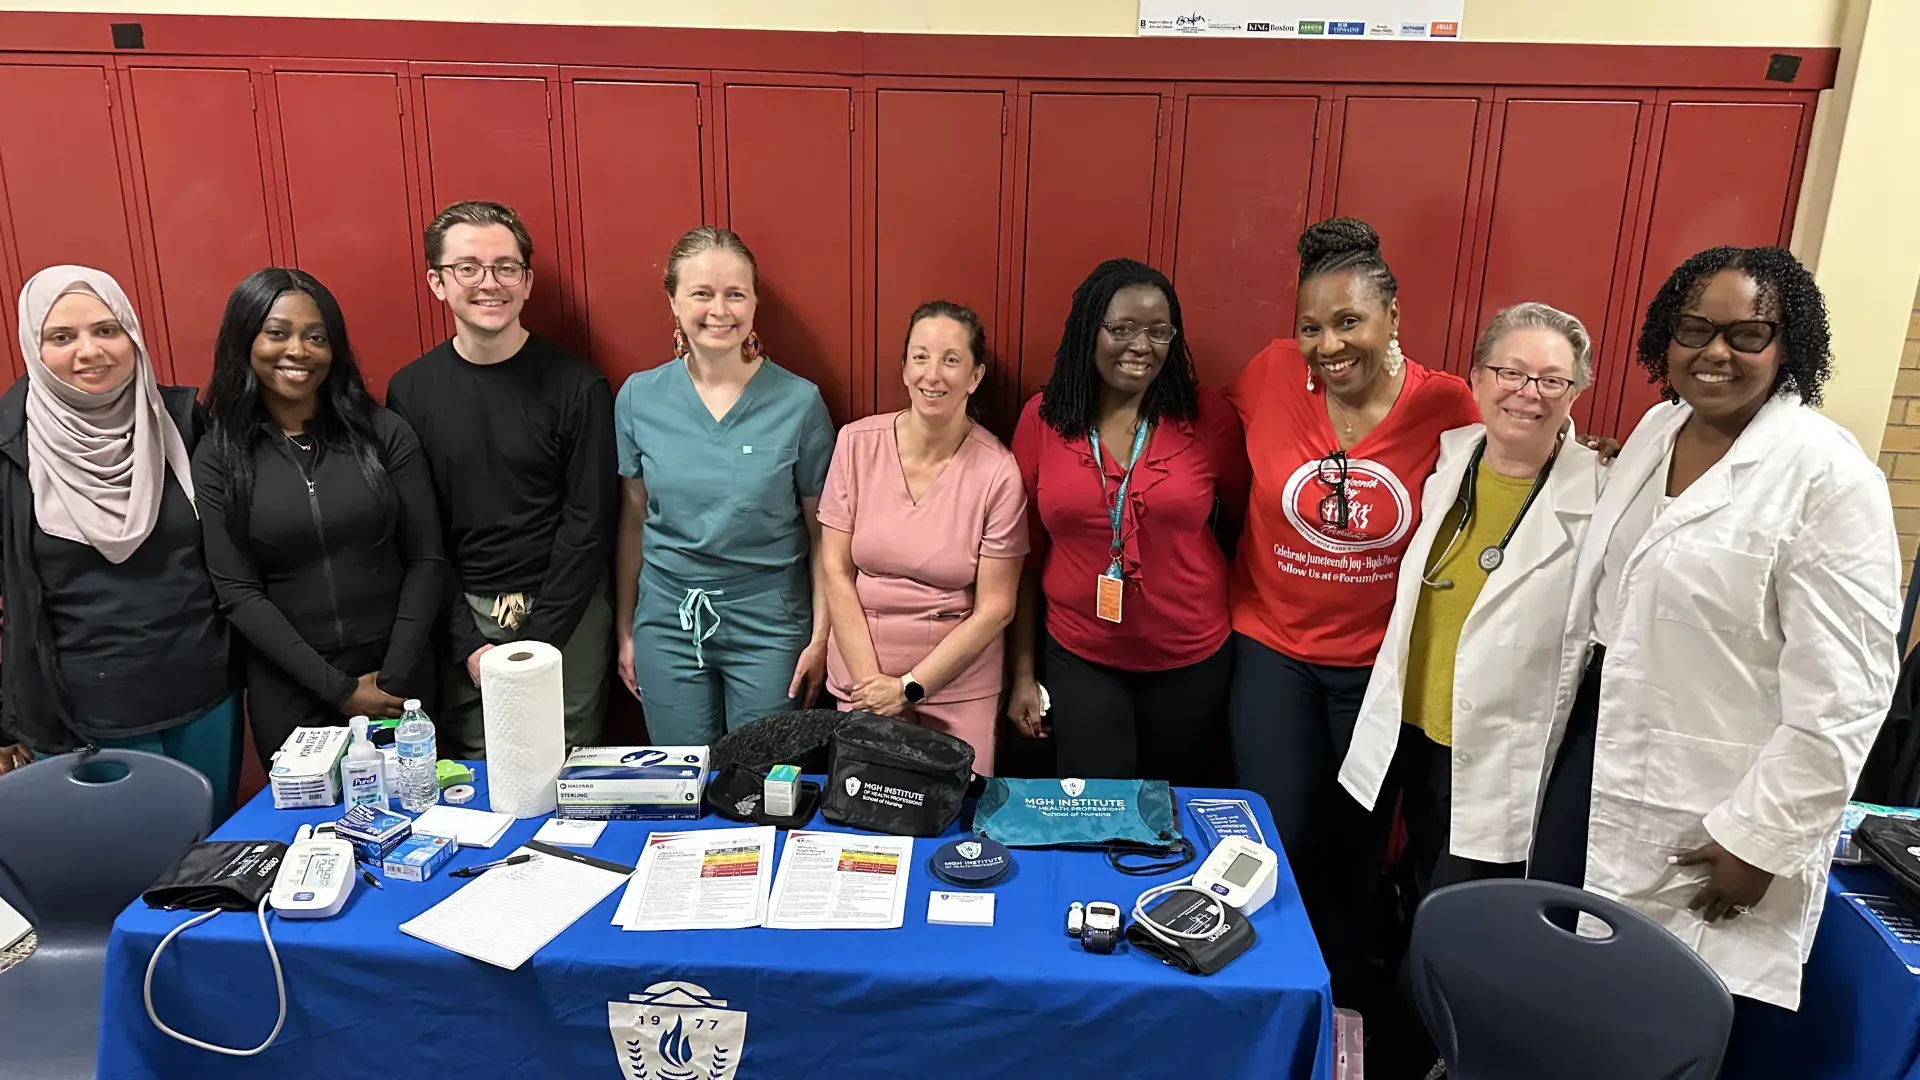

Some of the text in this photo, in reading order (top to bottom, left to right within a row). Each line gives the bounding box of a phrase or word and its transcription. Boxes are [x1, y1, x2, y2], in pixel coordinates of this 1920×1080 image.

[1316, 540, 1330, 550] HYDE
[1273, 543, 1306, 563] Celebrate
[1305, 552, 1348, 569] Juneteenth
[1347, 557, 1362, 572] Joy
[1366, 555, 1383, 571] Hyde
[1277, 561, 1306, 577] Follow
[1309, 569, 1320, 580] Us
[1322, 571, 1331, 581] at
[864, 783, 925, 801] MGH INSTITUTE
[871, 791, 890, 799] HEALTH
[862, 795, 879, 803] School
[884, 800, 903, 809] Nursing
[1024, 798, 1125, 807] MGH INSTITUTE
[315, 859, 335, 869] 125
[964, 856, 1003, 865] INSTITUTE
[316, 869, 331, 880] 76
